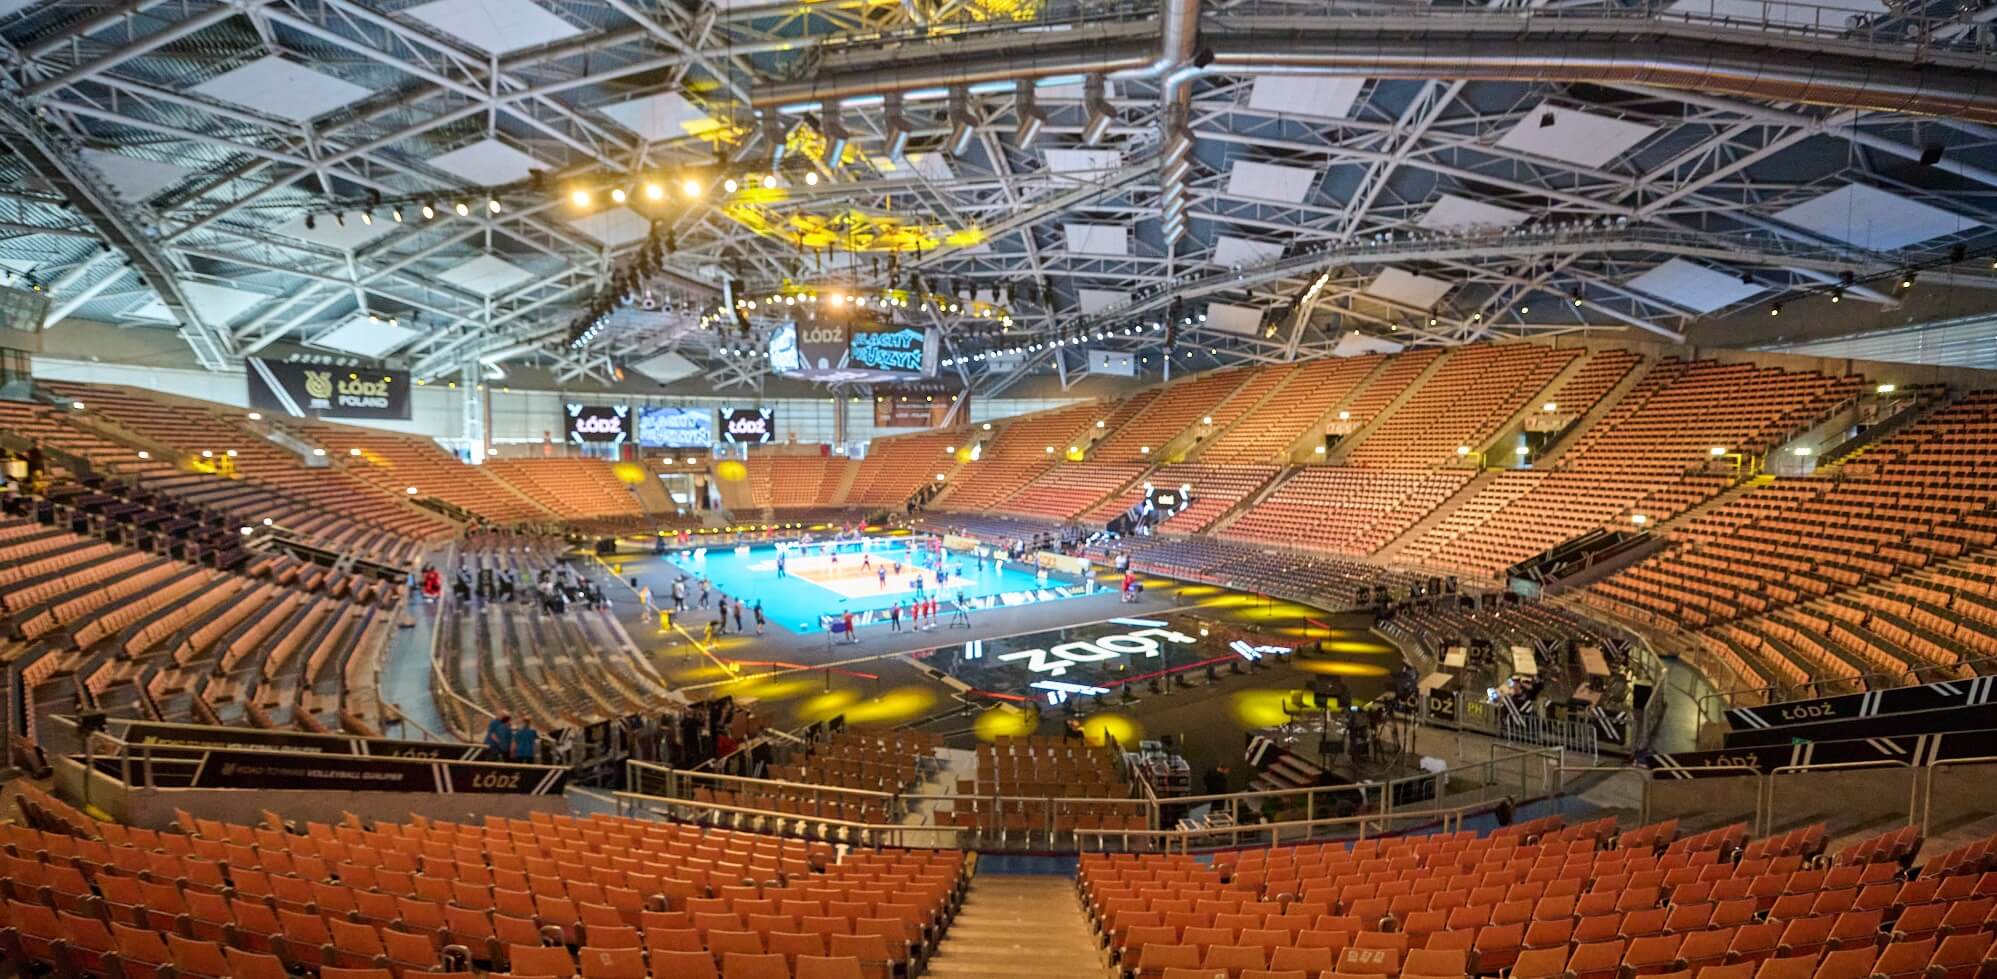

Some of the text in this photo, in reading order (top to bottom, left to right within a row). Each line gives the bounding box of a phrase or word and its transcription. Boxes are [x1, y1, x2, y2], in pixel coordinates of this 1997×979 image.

[802, 326, 844, 343] ŁÓDŹ
[338, 396, 389, 408] POLAND
[576, 415, 622, 433] ŁÓDŹ
[728, 417, 767, 434] ŁÓDŹ
[1781, 702, 1836, 720] ŁÓDŹ
[472, 770, 521, 788] ŁÓDŹ
